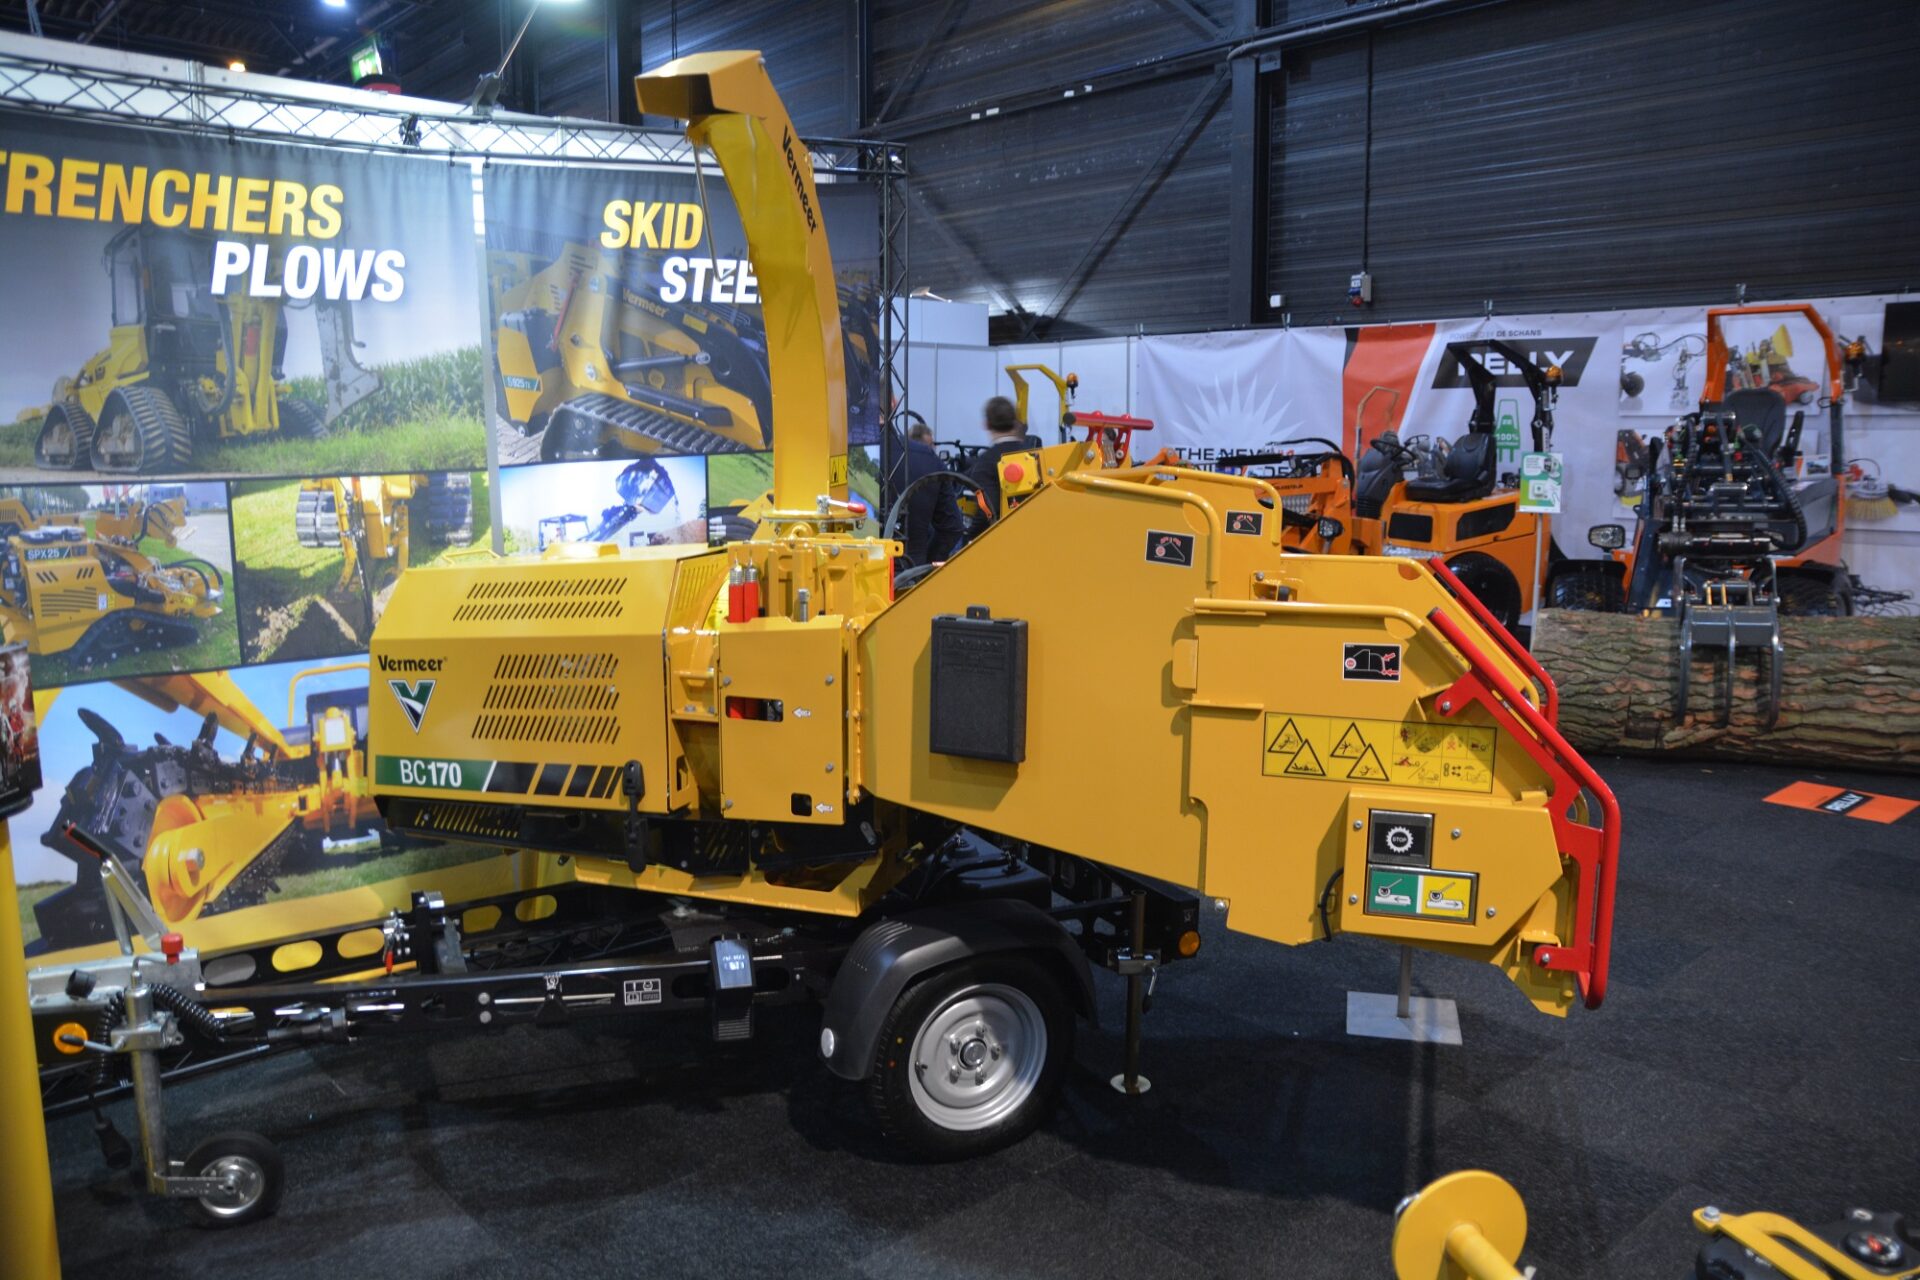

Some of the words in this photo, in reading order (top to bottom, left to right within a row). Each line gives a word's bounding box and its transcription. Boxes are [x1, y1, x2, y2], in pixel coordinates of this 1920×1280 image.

[0, 150, 344, 239] RENCHERS
[783, 123, 817, 234] Vermeer
[600, 199, 704, 249] SKID
[211, 240, 407, 302] PLOWS
[659, 256, 762, 304] STEE
[1496, 329, 1506, 337] DE
[1508, 328, 1542, 337] SCHANS
[1175, 447, 1215, 461] THE
[27, 549, 60, 560] SPX25
[378, 655, 443, 672] Vermeer
[399, 758, 463, 788] BC170
